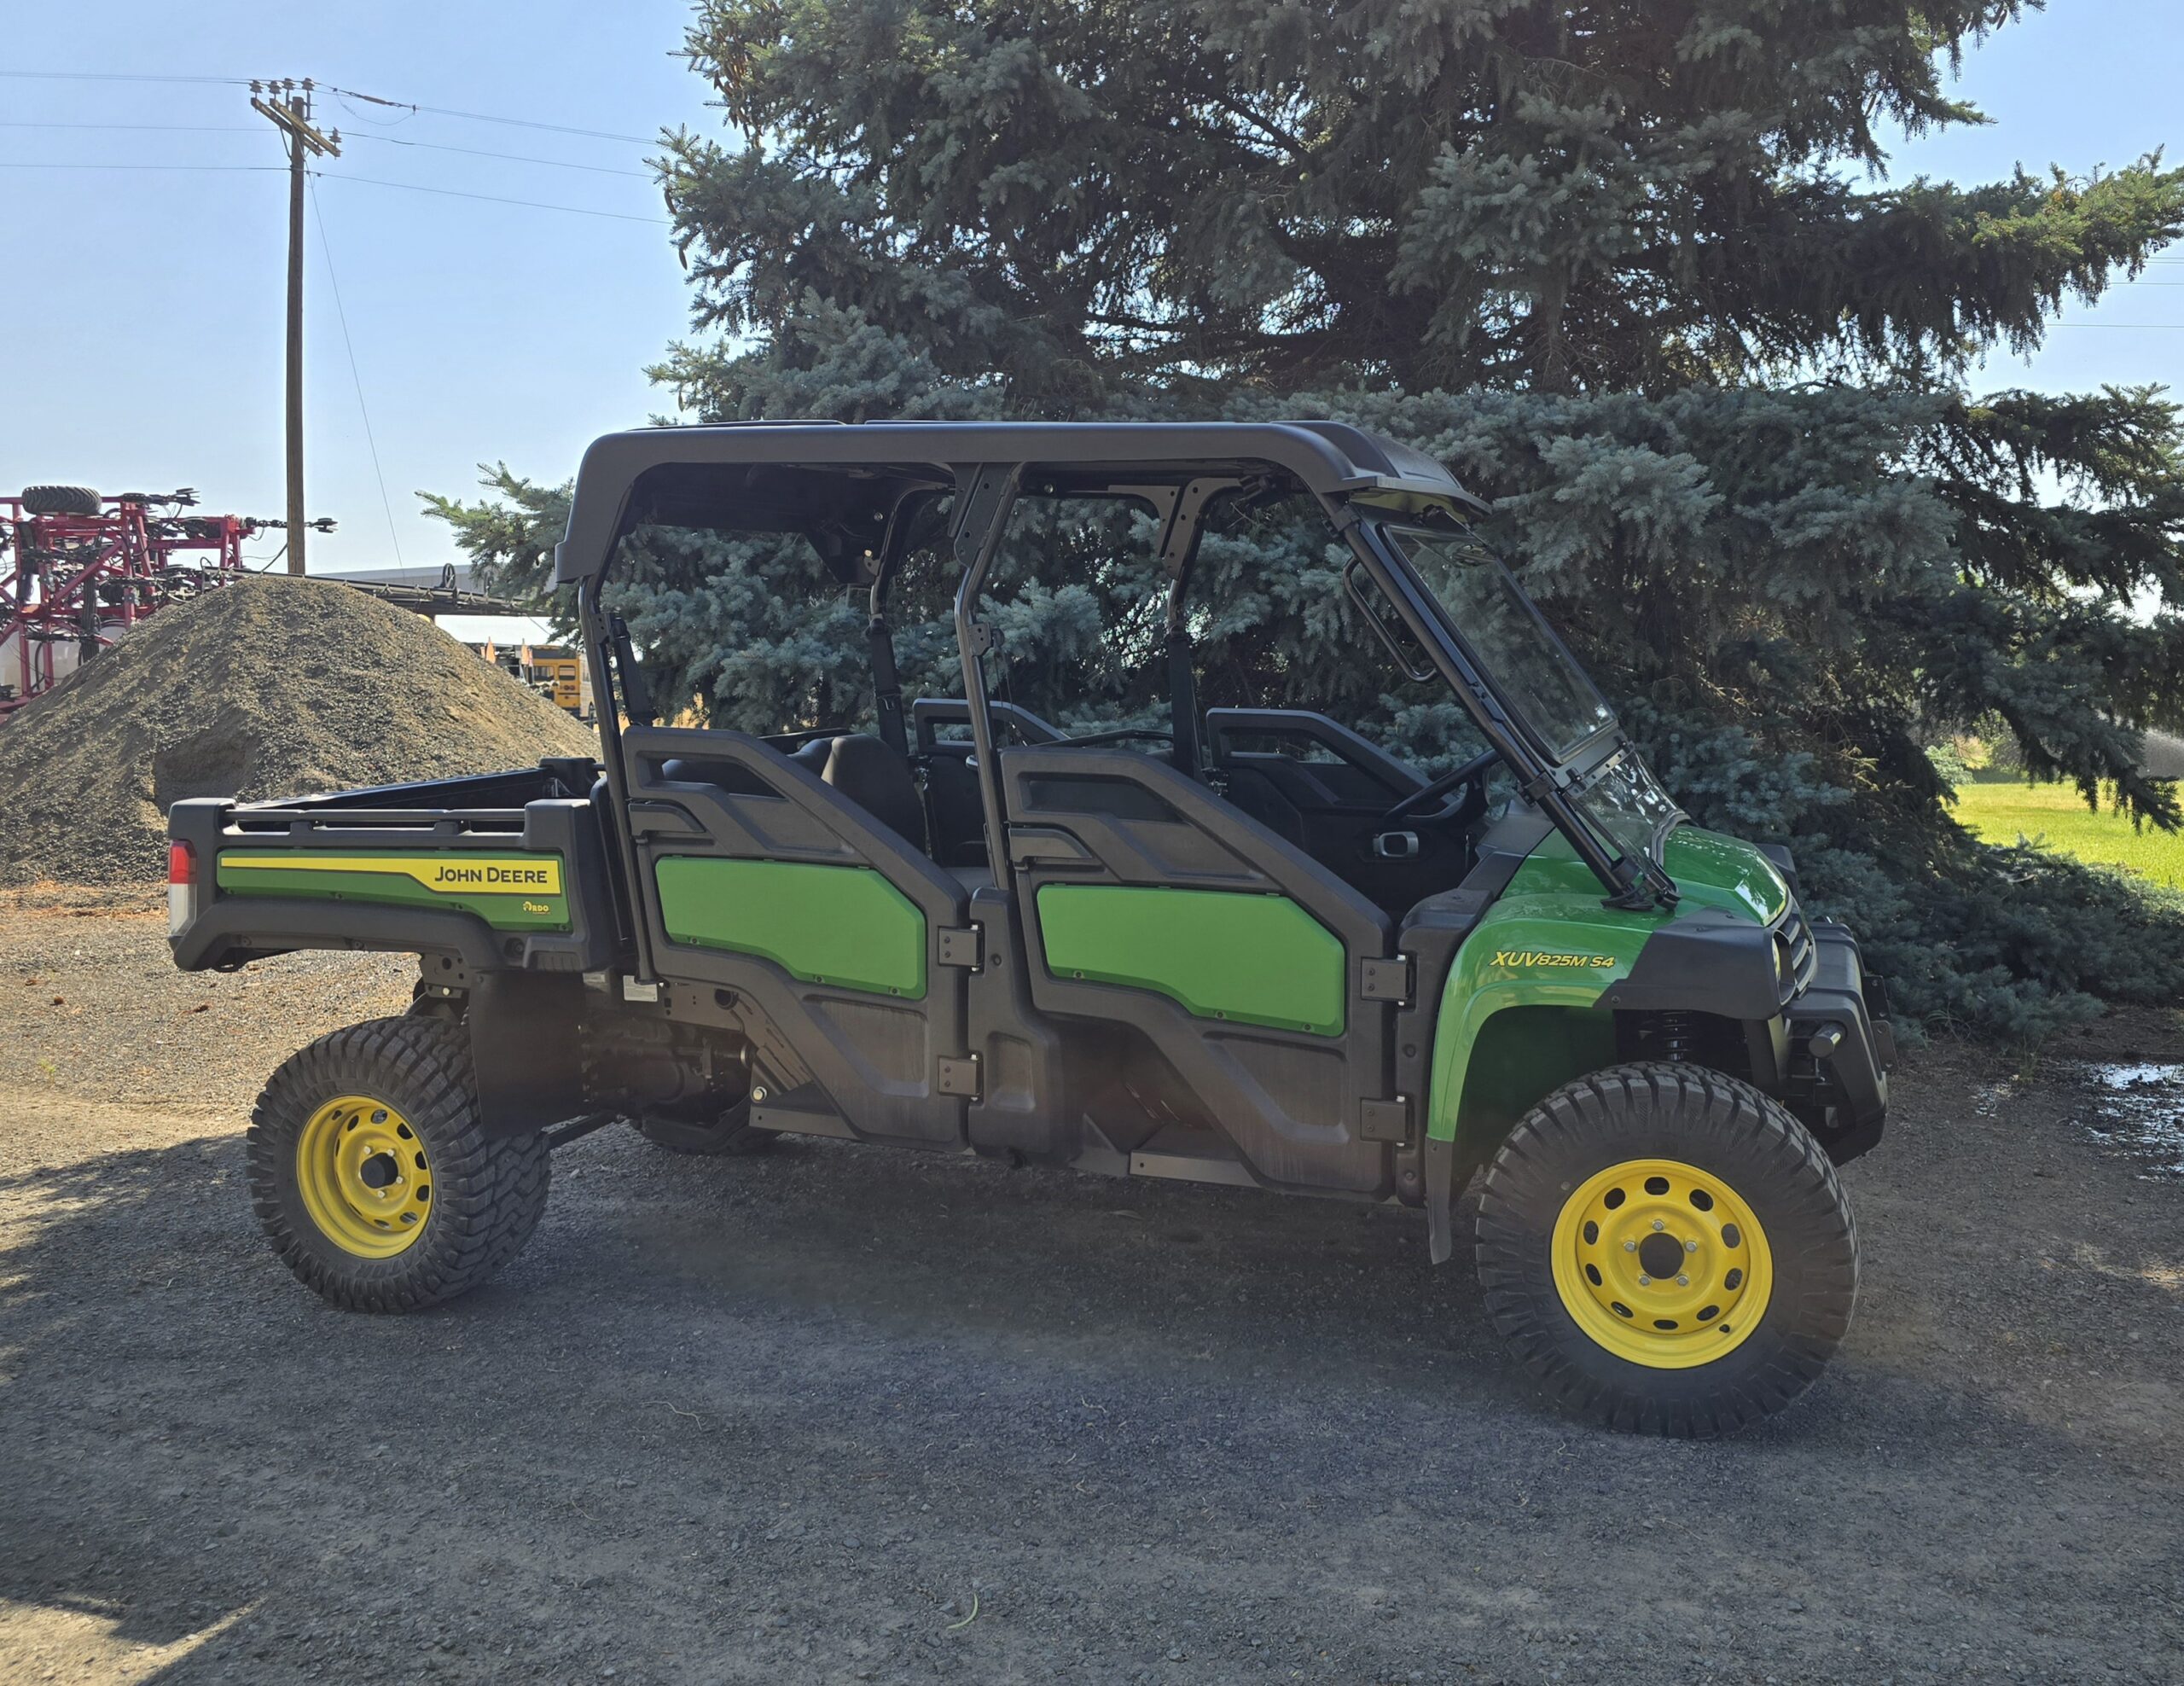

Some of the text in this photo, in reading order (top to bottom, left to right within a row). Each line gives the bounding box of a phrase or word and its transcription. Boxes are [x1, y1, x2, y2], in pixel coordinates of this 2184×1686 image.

[434, 866, 548, 884] JOHN DEERE
[1490, 951, 1615, 968] XUV825M S4
